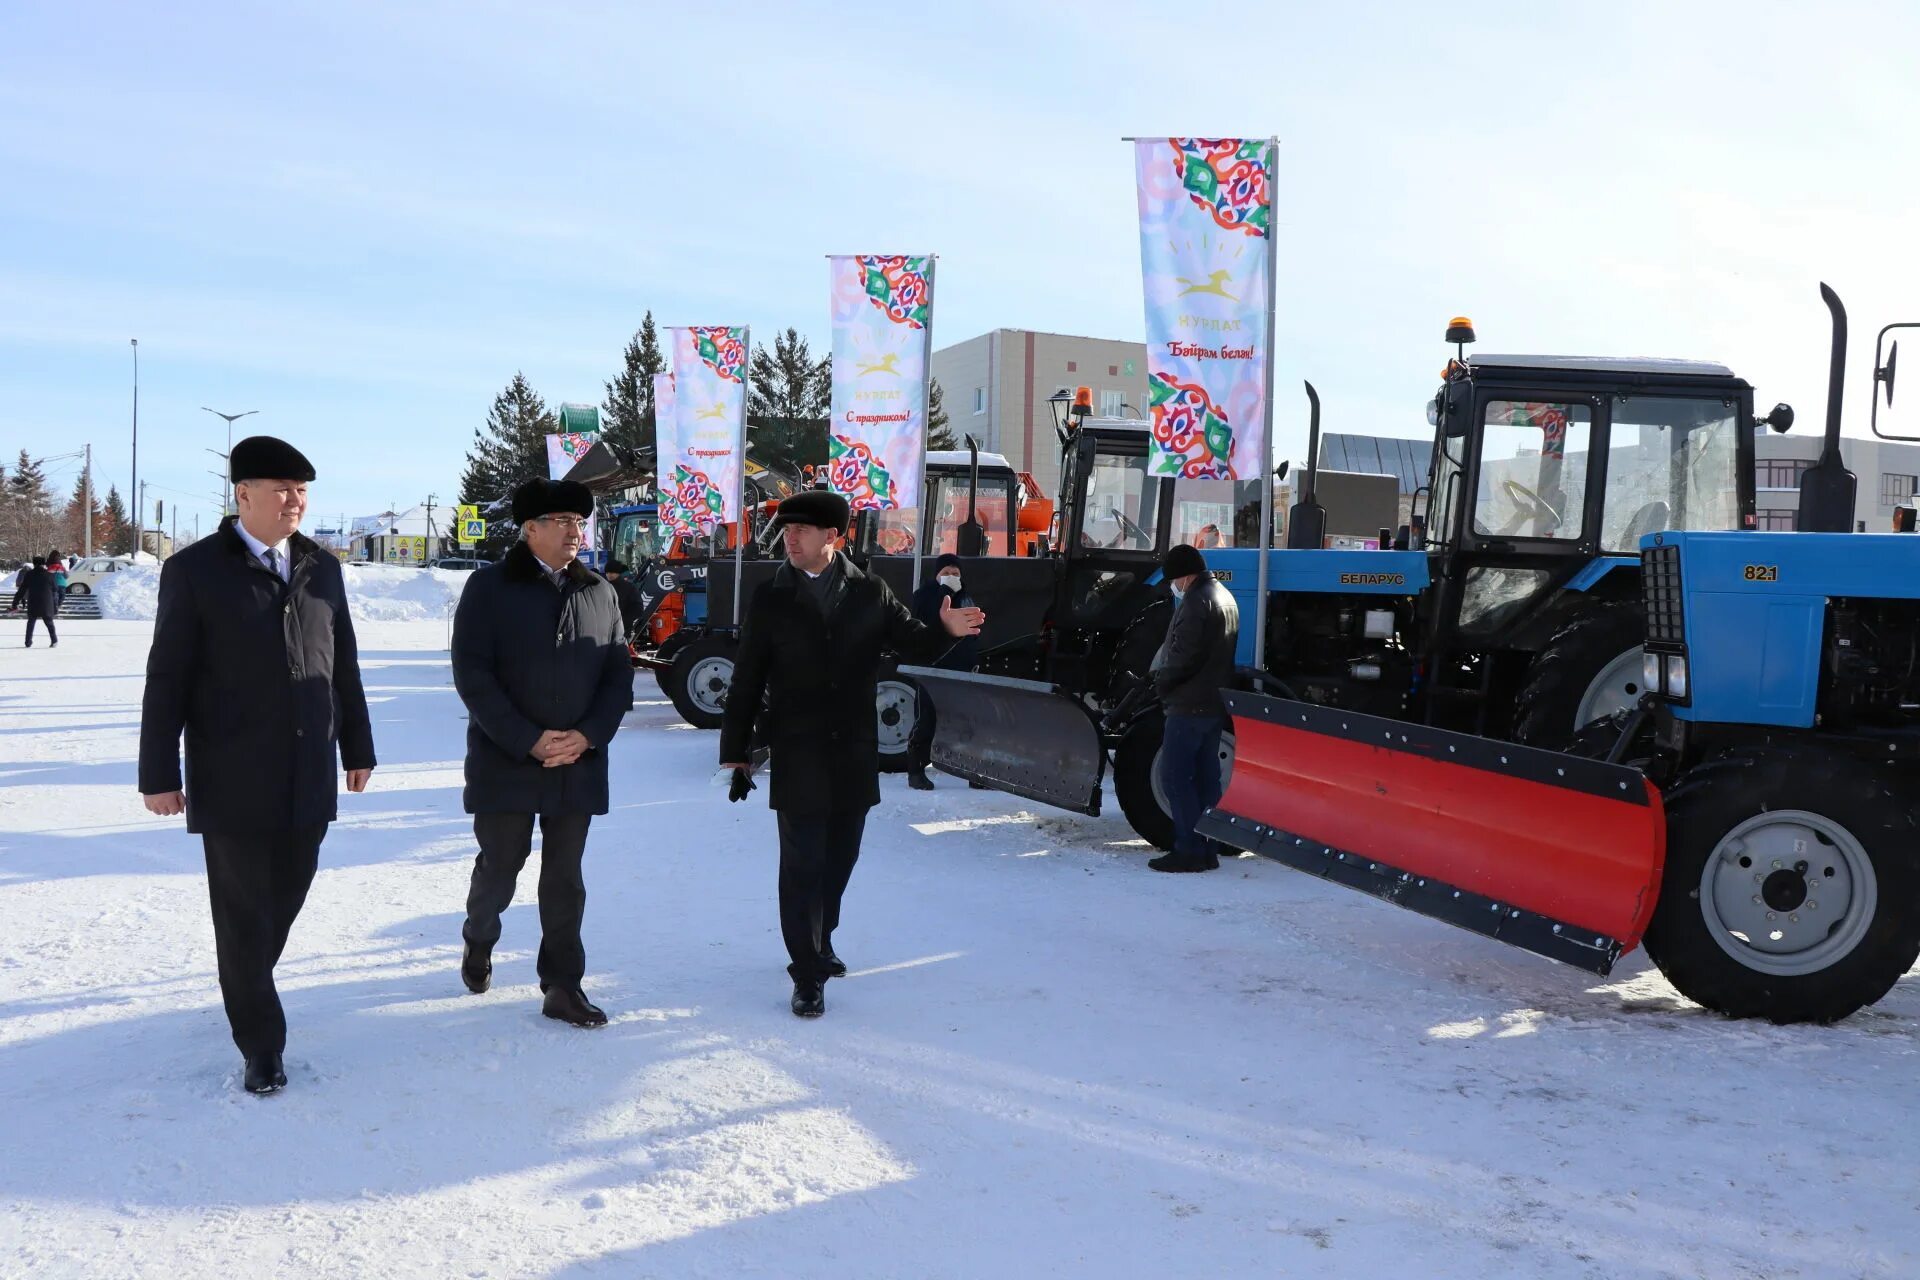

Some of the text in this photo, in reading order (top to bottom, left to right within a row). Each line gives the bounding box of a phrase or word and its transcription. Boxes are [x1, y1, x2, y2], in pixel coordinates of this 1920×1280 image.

[1178, 314, 1241, 331] НУРЛАТ
[856, 409, 911, 427] праздником!
[1340, 573, 1404, 585] БЕЛАРУС
[1744, 565, 1777, 581] 82.1
